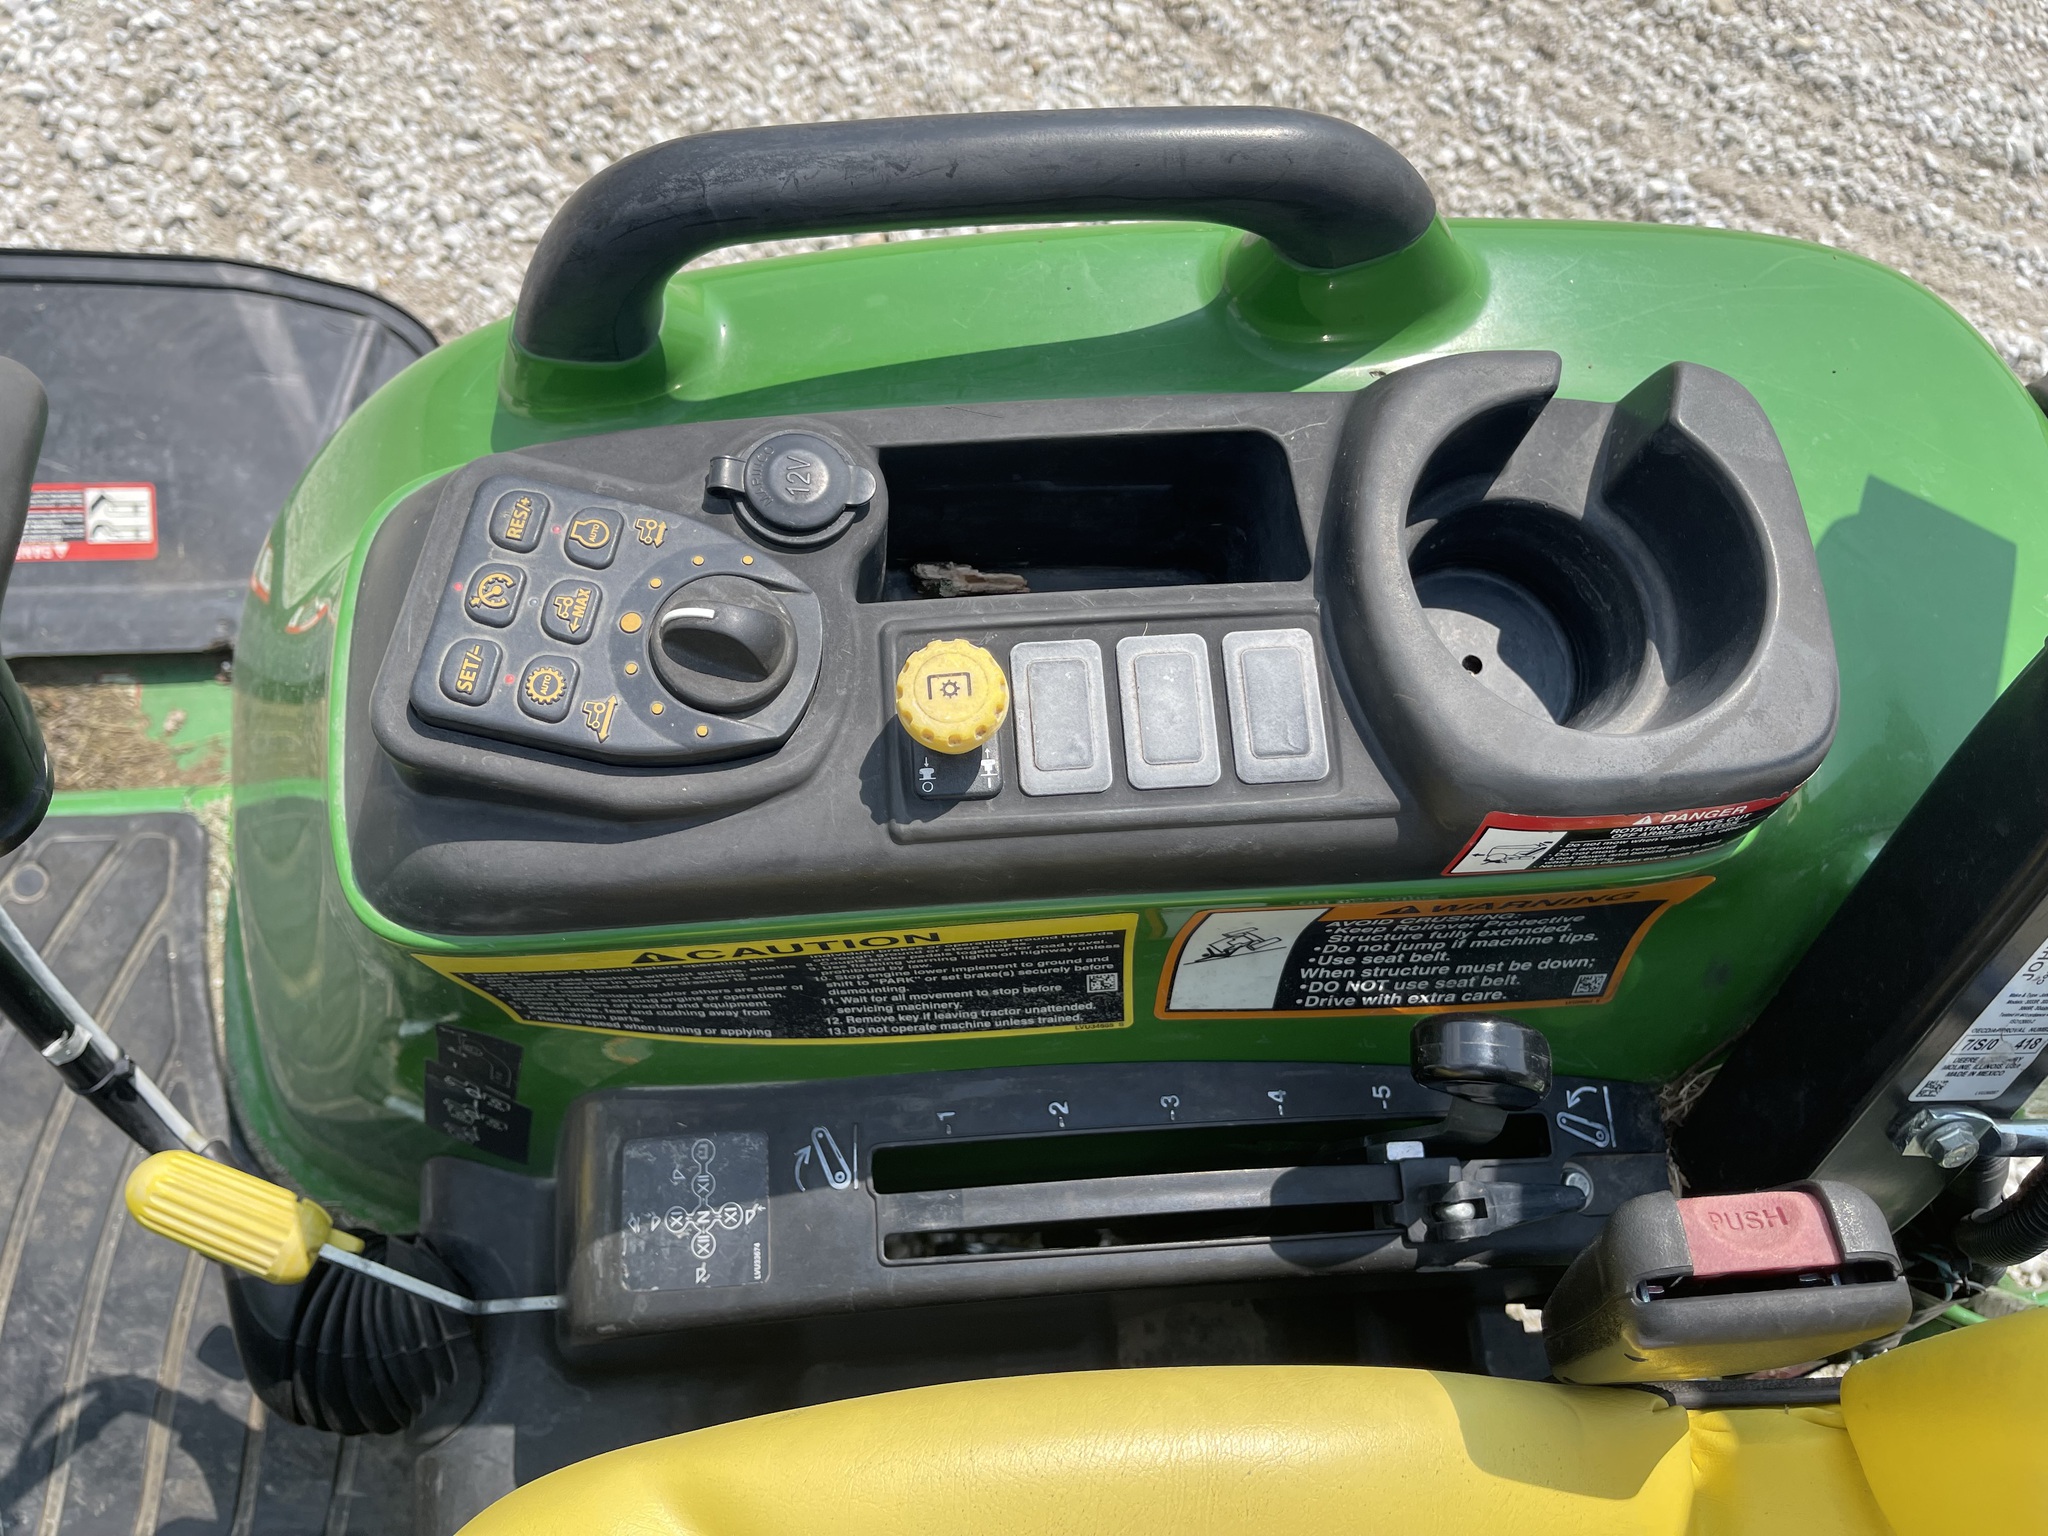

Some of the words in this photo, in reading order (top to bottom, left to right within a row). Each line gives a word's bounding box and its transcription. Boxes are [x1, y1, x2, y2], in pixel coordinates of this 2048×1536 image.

[785, 455, 812, 496] 12V
[505, 496, 533, 542] RES/+
[589, 524, 600, 542] AUTO
[573, 588, 592, 618] MAX
[456, 645, 483, 694] SET/-
[540, 675, 551, 695] AUTO
[1610, 824, 1673, 835] ROTATING
[1673, 818, 1724, 830] BLADES
[1726, 812, 1752, 822] CUT
[1659, 805, 1748, 823] DANGER
[1431, 891, 1640, 912] WARNING
[1326, 918, 1394, 927] AVOID
[1400, 913, 1521, 924] CRUSHING:
[1334, 926, 1387, 935] Keep
[1392, 923, 1479, 932] Rollover
[1484, 915, 1586, 928] Protective
[1328, 932, 1423, 943] Structure
[1428, 930, 1473, 942] fully
[1477, 924, 1572, 937] extended.
[686, 932, 941, 960] CAUTION
[906, 955, 957, 965] warning
[961, 952, 999, 962] lights
[1020, 946, 1073, 957] highway
[1078, 943, 1120, 951] unless
[1036, 941, 1065, 949] road
[1322, 945, 1350, 954] Do
[1356, 943, 1391, 953] not
[1392, 942, 1446, 956] jump
[1450, 940, 1468, 950] if
[1469, 935, 1554, 948] machine
[1558, 933, 1599, 945] tips.
[1300, 967, 1355, 979] When
[1360, 964, 1450, 977] structure
[1454, 961, 1505, 974] must
[1508, 959, 1532, 971] be
[1537, 957, 1596, 970] down;
[1317, 955, 1356, 965] Use
[1361, 954, 1405, 964] seat
[1409, 951, 1451, 962] belt.
[2021, 946, 2048, 981] JOH
[814, 975, 832, 983] 10.
[835, 973, 865, 982] Stop
[867, 970, 911, 980] engine
[913, 967, 948, 976] lower
[951, 961, 1018, 975] implement
[1037, 956, 1082, 969] ground
[1085, 955, 1109, 963] and
[821, 965, 892, 977] prohibited
[894, 965, 904, 973] by
[908, 962, 932, 970] law.
[826, 980, 855, 989] shift
[941, 973, 961, 981] set
[963, 969, 1015, 980] brake(s)
[1018, 966, 1071, 978] securely
[1074, 962, 1114, 971] before
[690, 987, 735, 995] others
[757, 984, 788, 992] clear
[791, 983, 804, 991] of
[828, 986, 910, 997] dismounting.
[1308, 981, 1340, 993] DO
[1345, 979, 1390, 992] NOT
[1393, 980, 1429, 990] use
[1434, 976, 1475, 988] seat
[1480, 974, 1521, 987] belt.
[723, 991, 787, 1003] operation.
[821, 997, 839, 1005] 11.
[841, 995, 869, 1004] Wait
[870, 994, 888, 1002] for
[891, 993, 906, 1001] all
[909, 988, 974, 1001] movement
[976, 988, 988, 997] to
[992, 986, 1020, 998] stop
[1022, 984, 1063, 993] before
[1304, 995, 1356, 1007] Drive
[1361, 993, 1402, 1005] with
[1407, 992, 1456, 1004] extra
[1461, 989, 1507, 1002] care.
[630, 1007, 654, 1016] and
[656, 1007, 707, 1019] clothing
[708, 1009, 739, 1019] away
[742, 1007, 771, 1016] from
[632, 1001, 673, 1009] tractor
[676, 1001, 700, 1009] and
[702, 999, 771, 1012] equipment.
[825, 1016, 843, 1025] 12.
[845, 1015, 895, 1024] Remove
[898, 1013, 919, 1025] key
[923, 1012, 932, 1020] if
[934, 1010, 980, 1022] leaving
[981, 1007, 1022, 1017] tractor
[1024, 1001, 1096, 1014] unattended.
[836, 1003, 894, 1015] servicing
[896, 1000, 963, 1012] machinery.
[537, 1015, 583, 1026] Reduce
[585, 1019, 621, 1031] speed
[623, 1021, 656, 1031] when
[657, 1023, 702, 1037] turning
[704, 1026, 717, 1035] or
[720, 1025, 773, 1040] applying
[605, 1014, 644, 1024] parts.
[827, 1027, 845, 1036] 13.
[848, 1026, 865, 1034] Do
[868, 1025, 890, 1033] not
[891, 1024, 938, 1036] operate
[940, 1020, 991, 1031] machine
[994, 1018, 1035, 1028] unless
[1037, 1013, 1083, 1024] trained.
[1961, 1038, 2000, 1051] 7/S/0
[2014, 1038, 2043, 1050] 418
[1707, 1206, 1789, 1231] PUSH
